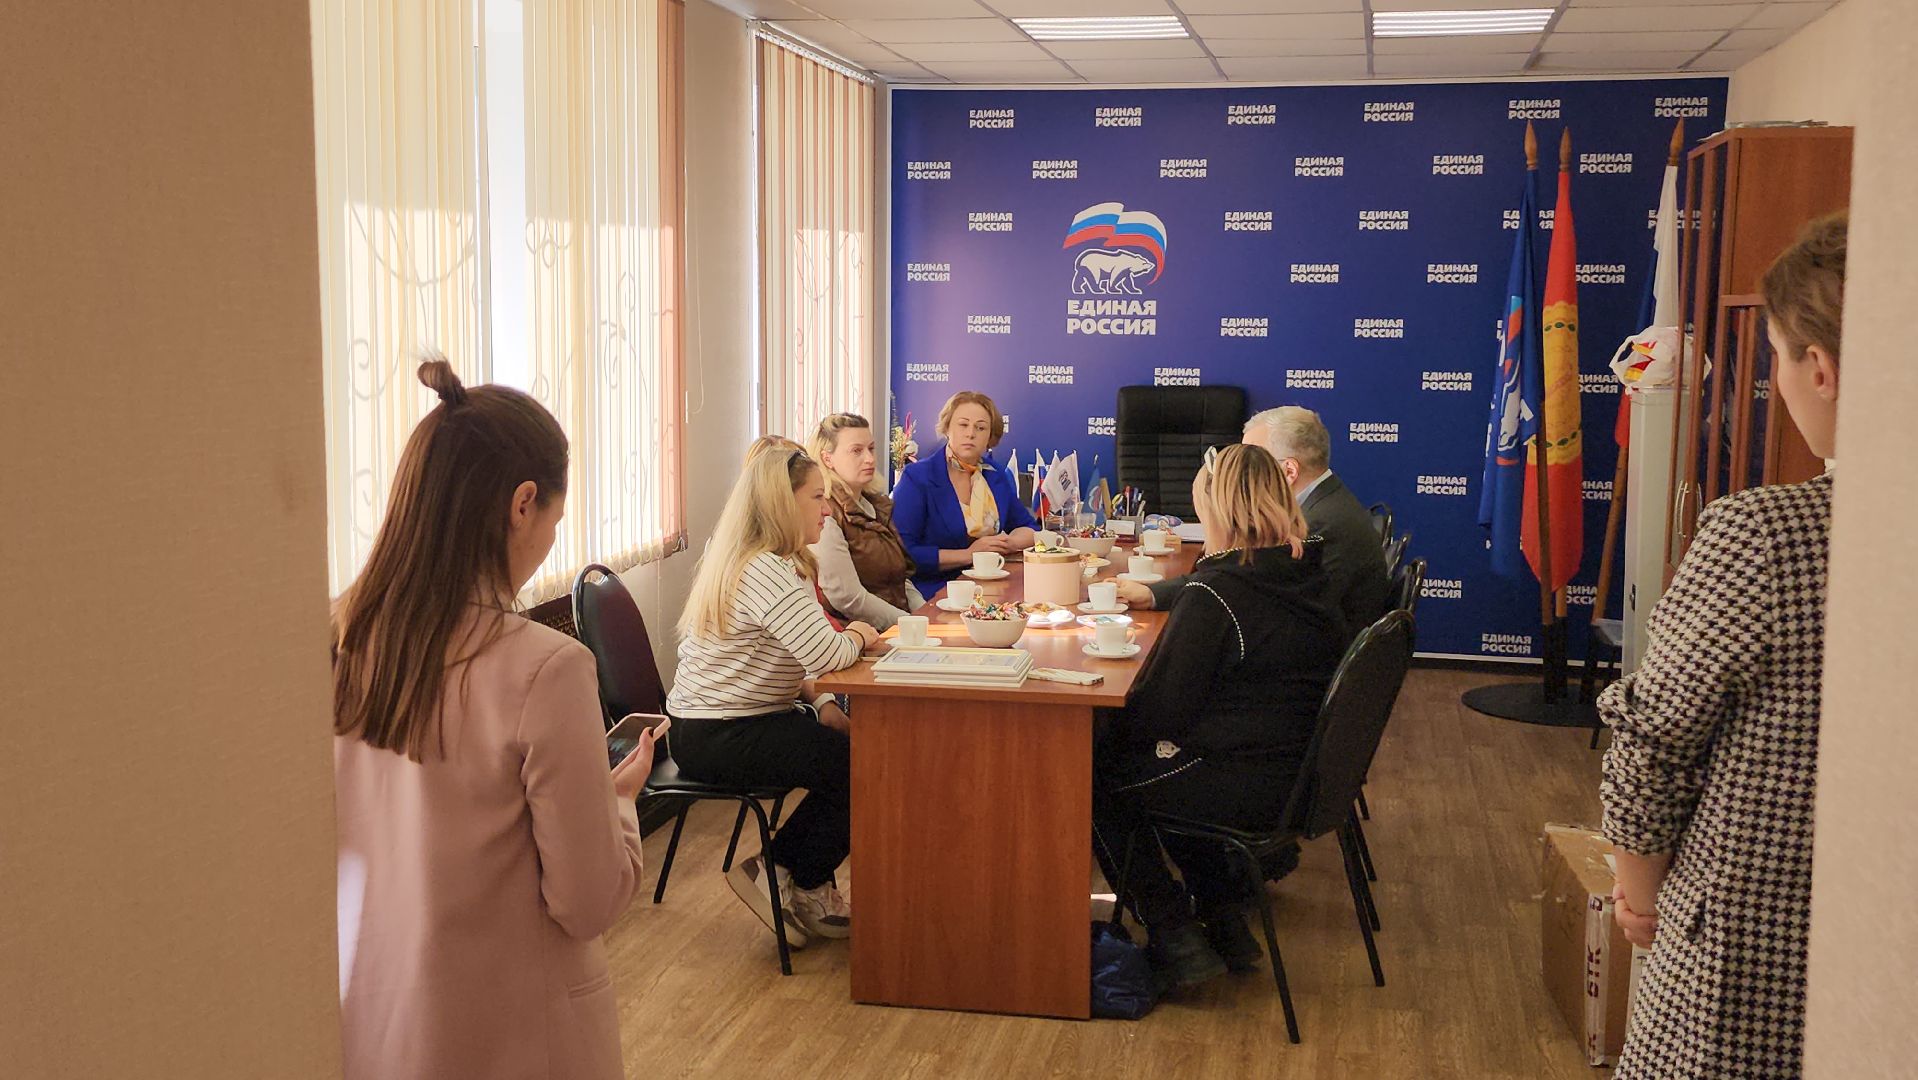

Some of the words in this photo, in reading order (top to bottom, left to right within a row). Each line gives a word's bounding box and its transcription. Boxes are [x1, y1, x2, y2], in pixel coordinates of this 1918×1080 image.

[1509, 100, 1560, 109] ЕДИНАЯ
[1656, 97, 1707, 107] ЕДИНАЯ
[1229, 105, 1275, 114] ЕДИНАЯ
[1365, 102, 1414, 112] ЕДИНАЯ
[970, 110, 1014, 118] ЕДИНАЯ
[1096, 108, 1141, 117] ЕДИНАЯ
[1364, 112, 1413, 121] РОССИЯ
[1509, 110, 1559, 119] РОССИЯ
[1655, 108, 1707, 117] РОССИЯ
[970, 119, 1013, 128] РОССИЯ
[1096, 117, 1141, 126] РОССИЯ
[1228, 114, 1275, 124] РОССИЯ
[1296, 157, 1343, 166] ЕДИНАЯ
[1434, 155, 1483, 164] ЕДИНАЯ
[1581, 154, 1632, 163] ЕДИНАЯ
[908, 162, 950, 170] ЕДИНАЯ
[1033, 161, 1077, 169] ЕДИНАЯ
[1161, 159, 1206, 168] ЕДИНАЯ
[1160, 169, 1206, 177] РОССИЯ
[1295, 167, 1343, 176] РОССИЯ
[1433, 165, 1483, 174] РОССИЯ
[1580, 164, 1631, 173] РОССИЯ
[908, 171, 950, 179] РОССИЯ
[1033, 170, 1077, 178] РОССИЯ
[969, 213, 1012, 222] ЕДИНАЯ
[1225, 212, 1272, 221] ЕДИНАЯ
[1360, 211, 1408, 220] ЕДИНАЯ
[1503, 210, 1554, 219] ЕДАЯ
[969, 223, 1012, 231] РОССИЯ
[1225, 222, 1271, 231] РОССИЯ
[1359, 221, 1408, 230] РОССИЯ
[908, 264, 950, 272] ЕДИНАЯ
[1291, 265, 1339, 273] ЕДИНАЯ
[1428, 265, 1477, 273] ЕДИНАЯ
[1576, 265, 1625, 274] ЕДИНАЯ
[908, 272, 950, 281] РОССИЯ
[1291, 274, 1338, 282] РОССИЯ
[1428, 274, 1477, 283] РОССИЯ
[1068, 300, 1156, 316] ЕДИНАЯ
[968, 315, 1010, 324] ЕДИНАЯ
[1221, 318, 1268, 327] ЕДИНАЯ
[1355, 319, 1403, 328] ЕДИНАЯ
[968, 325, 1010, 333] РОССИЯ
[1067, 319, 1156, 335] РОССИЯ
[1221, 328, 1267, 336] РОССИЯ
[1355, 329, 1403, 337] РОССИЯ
[907, 364, 949, 372] ЕДИНАЯ
[1029, 366, 1073, 374] ЕДИНАЯ
[1155, 368, 1200, 376] ЕДИНАЯ
[907, 373, 949, 381] РОССИЯ
[1287, 370, 1334, 378] ЕДИНАЯ
[1423, 372, 1472, 381] ЕДИНАЯ
[1029, 374, 1073, 384] РОССИЯ
[1154, 376, 1199, 386] РОССИЯ
[1286, 379, 1333, 388] РОССИЯ
[1422, 382, 1471, 390] РОССИЯ
[1088, 417, 1117, 426] ЕДИН
[1088, 426, 1116, 436] РОСС
[1350, 423, 1398, 432] ЕДИНАЯ
[1350, 433, 1398, 442] РОССИЯ
[1418, 476, 1466, 485] ЕДИНАЯ
[1417, 485, 1466, 495] РОССИЯ
[1422, 579, 1462, 588] ДИНАЯ
[1420, 589, 1462, 598] ОССИЯ
[1566, 595, 1597, 605] ОССИ
[1482, 634, 1531, 643] ЕДИНАЯ
[1482, 644, 1530, 654] РОССИЯ
